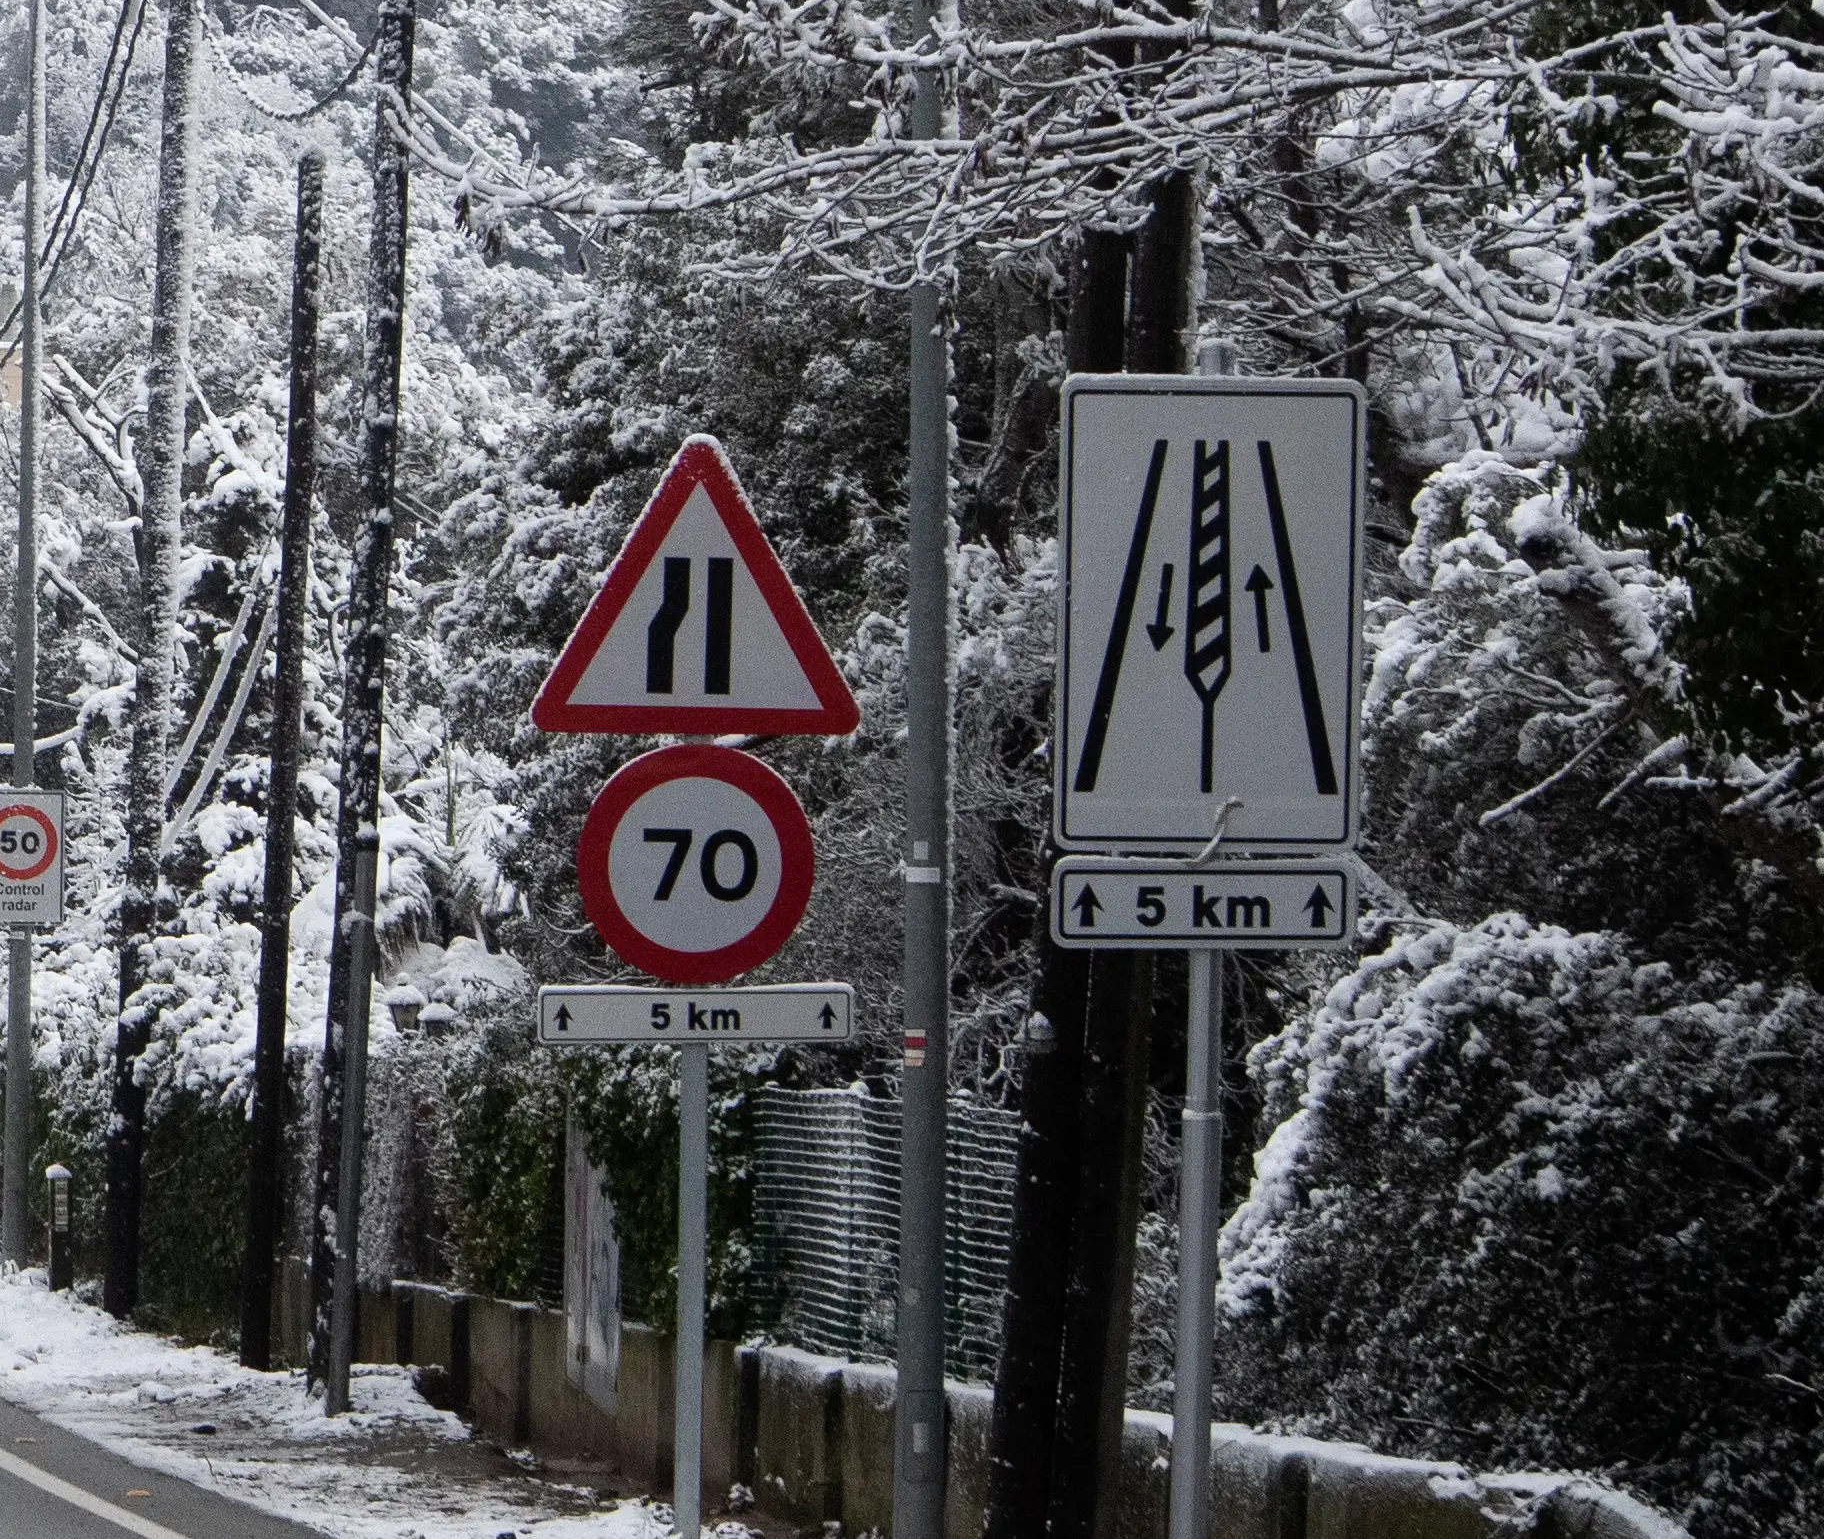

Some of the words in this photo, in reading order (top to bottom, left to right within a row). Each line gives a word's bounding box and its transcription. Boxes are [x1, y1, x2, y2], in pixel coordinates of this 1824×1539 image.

[0, 830, 40, 854] 50
[643, 828, 759, 902] 70
[1, 899, 38, 911] radar
[1135, 885, 1167, 927] 5
[1192, 884, 1271, 928] km
[650, 1002, 671, 1031] 5
[688, 1001, 741, 1031] km
